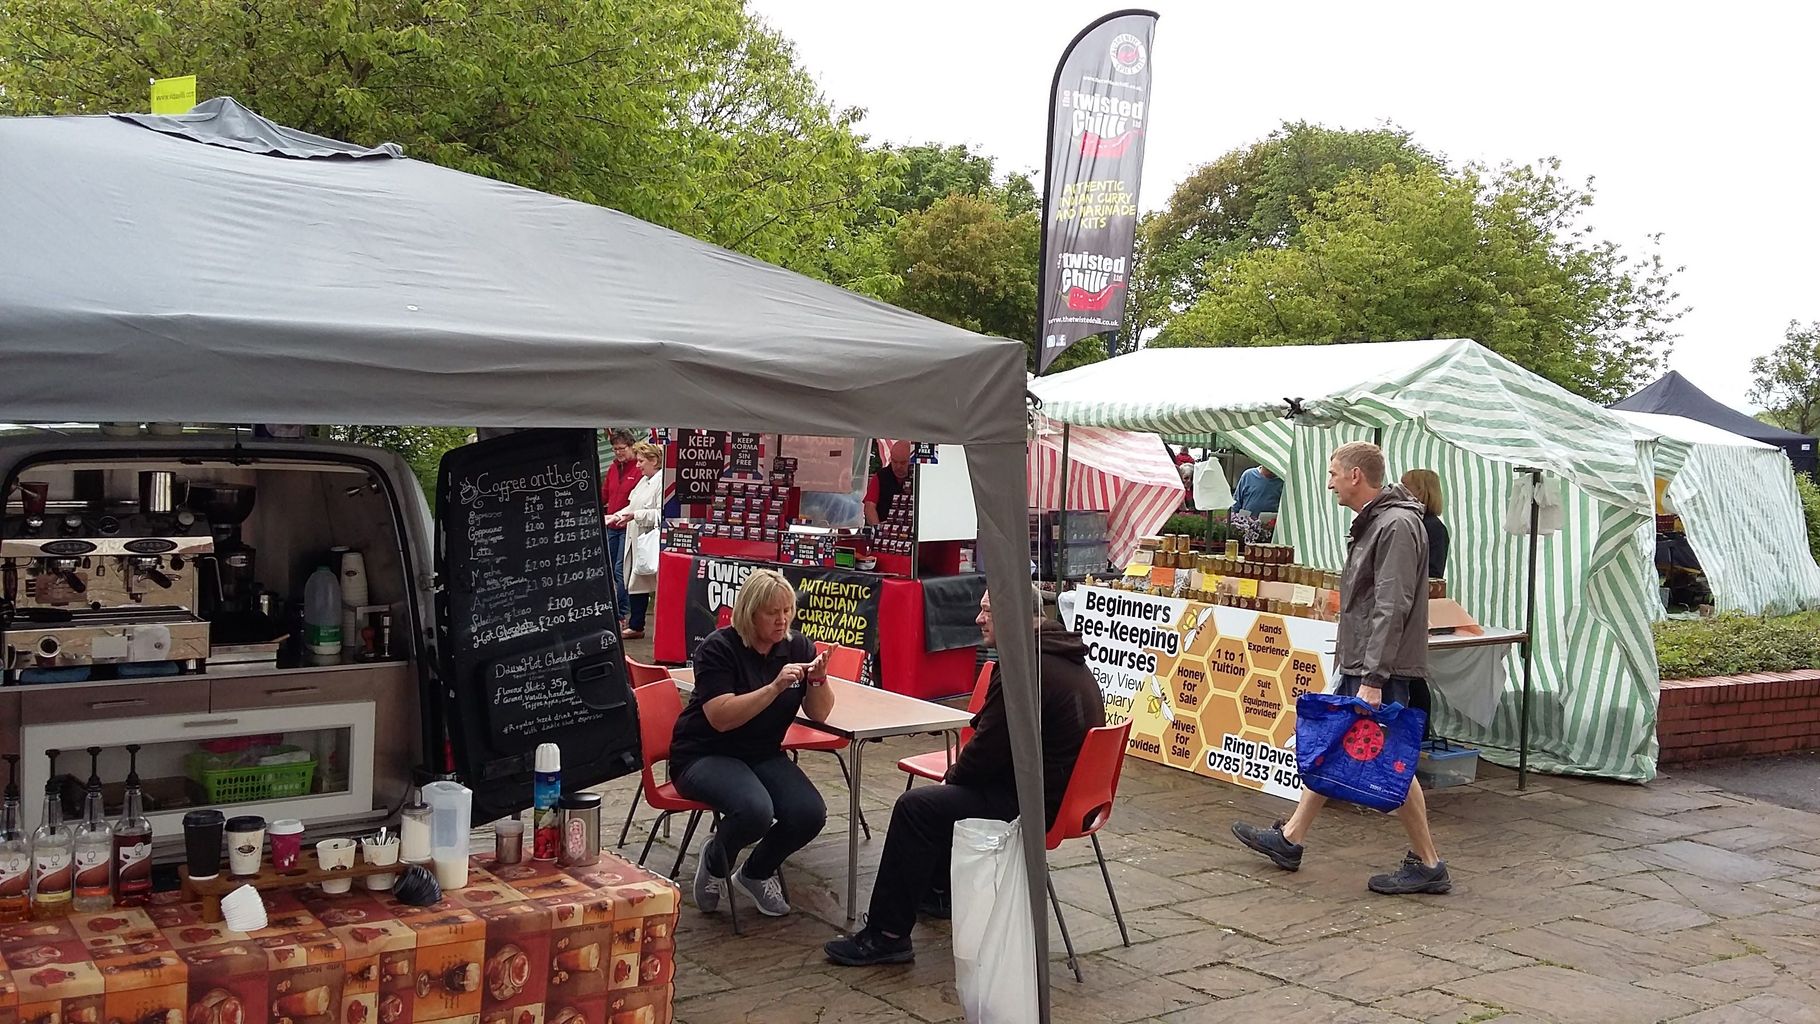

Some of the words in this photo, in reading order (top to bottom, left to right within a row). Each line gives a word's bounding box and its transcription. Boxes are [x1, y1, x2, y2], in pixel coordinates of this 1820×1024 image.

[1072, 91, 1144, 119] twisted
[1097, 192, 1133, 204] CURRY
[1080, 217, 1107, 229] KITS
[1063, 251, 1126, 274] twisted
[688, 435, 716, 448] KEEP
[732, 443, 758, 451] KORMA
[679, 448, 724, 461] KORMA
[681, 468, 720, 480] CURRY
[477, 471, 527, 502] Coffee
[690, 481, 710, 493] ON
[697, 559, 706, 579] the
[798, 577, 871, 599] AUTHENTIC
[809, 594, 857, 613] INDIAN
[1085, 591, 1171, 623] Beginners
[797, 608, 840, 626] CURRY
[839, 613, 868, 630] AND
[800, 622, 865, 645] MARINADE
[1074, 614, 1179, 654] Bee-Keeping
[1259, 623, 1282, 635] Hands
[1264, 635, 1275, 644] on
[1216, 648, 1221, 659] 1
[1224, 650, 1235, 662] to
[1238, 653, 1244, 663] 1
[1247, 642, 1290, 657] Experience
[1088, 642, 1156, 673] Courses
[1177, 666, 1205, 682] Honey
[1211, 660, 1245, 676] Tuition
[1292, 659, 1317, 674] Bees
[550, 678, 568, 692] 35p
[1092, 667, 1113, 689] Bay
[1117, 672, 1145, 691] View
[1182, 680, 1197, 692] for
[1257, 680, 1272, 690] Suit
[1295, 673, 1312, 687] for
[1179, 692, 1198, 705] Sale
[1260, 689, 1266, 698] &
[1243, 695, 1281, 711] Equipment
[1245, 706, 1277, 720] provided
[1172, 719, 1196, 734] Hives
[1128, 737, 1160, 755] ovided
[1175, 733, 1190, 745] for
[1171, 745, 1190, 759] Sale
[1223, 736, 1255, 760] Ring
[1259, 744, 1297, 768] Dave:
[1208, 751, 1241, 773] 0785
[1244, 761, 1270, 781] 233
[1274, 769, 1303, 791] 450
